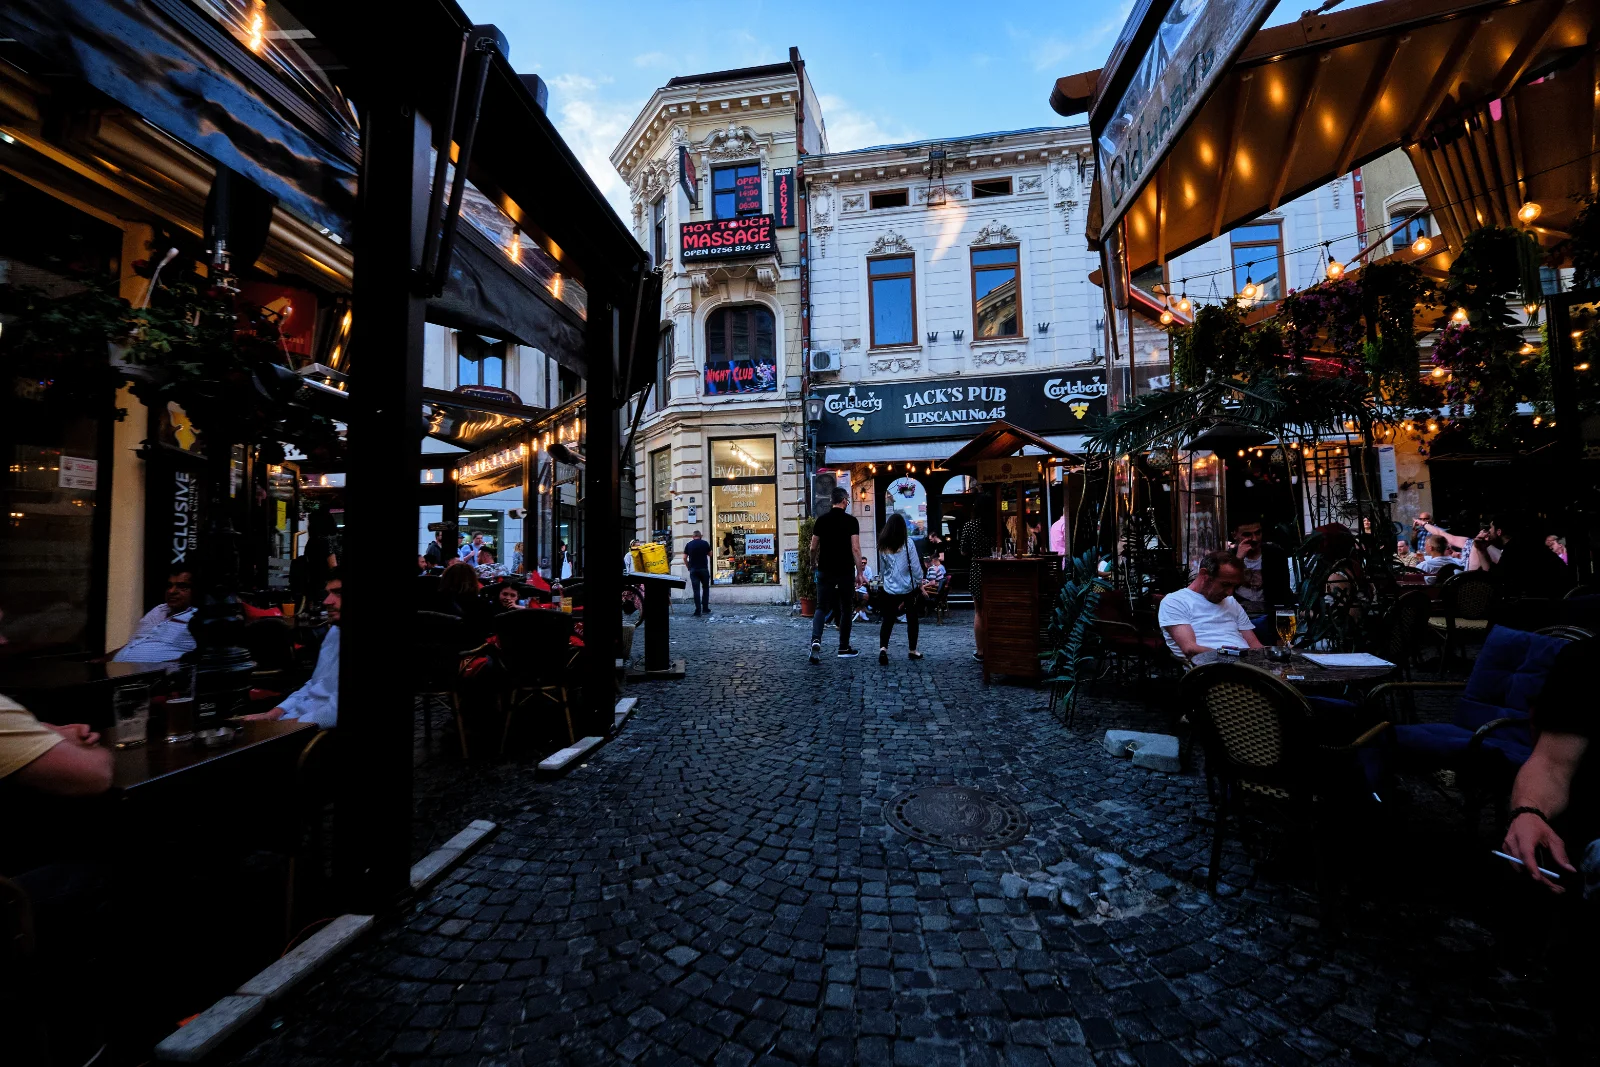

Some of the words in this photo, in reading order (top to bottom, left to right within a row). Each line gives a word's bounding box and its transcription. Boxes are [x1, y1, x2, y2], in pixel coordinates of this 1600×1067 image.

[1147, 49, 1215, 154] HABITS
[737, 177, 760, 185] OPEN
[779, 176, 788, 225] JACUZZI
[683, 223, 714, 233] HOT
[718, 217, 770, 230] TOUCH
[683, 226, 770, 249] MASSAGE
[684, 248, 709, 257] OPEN
[711, 246, 733, 254] 0756
[735, 244, 752, 252] 874
[754, 242, 771, 250] 772
[706, 369, 731, 384] NIGHT
[732, 366, 754, 382] CLUB
[903, 387, 963, 409] JACK'S
[967, 386, 1007, 402] PUB
[1044, 376, 1108, 403] Carlsberg
[825, 392, 883, 417] Carlsberg
[905, 410, 967, 424] LIPSCANI
[170, 471, 189, 564] XCLUSIVE
[718, 512, 770, 523] SOUVENIRS
